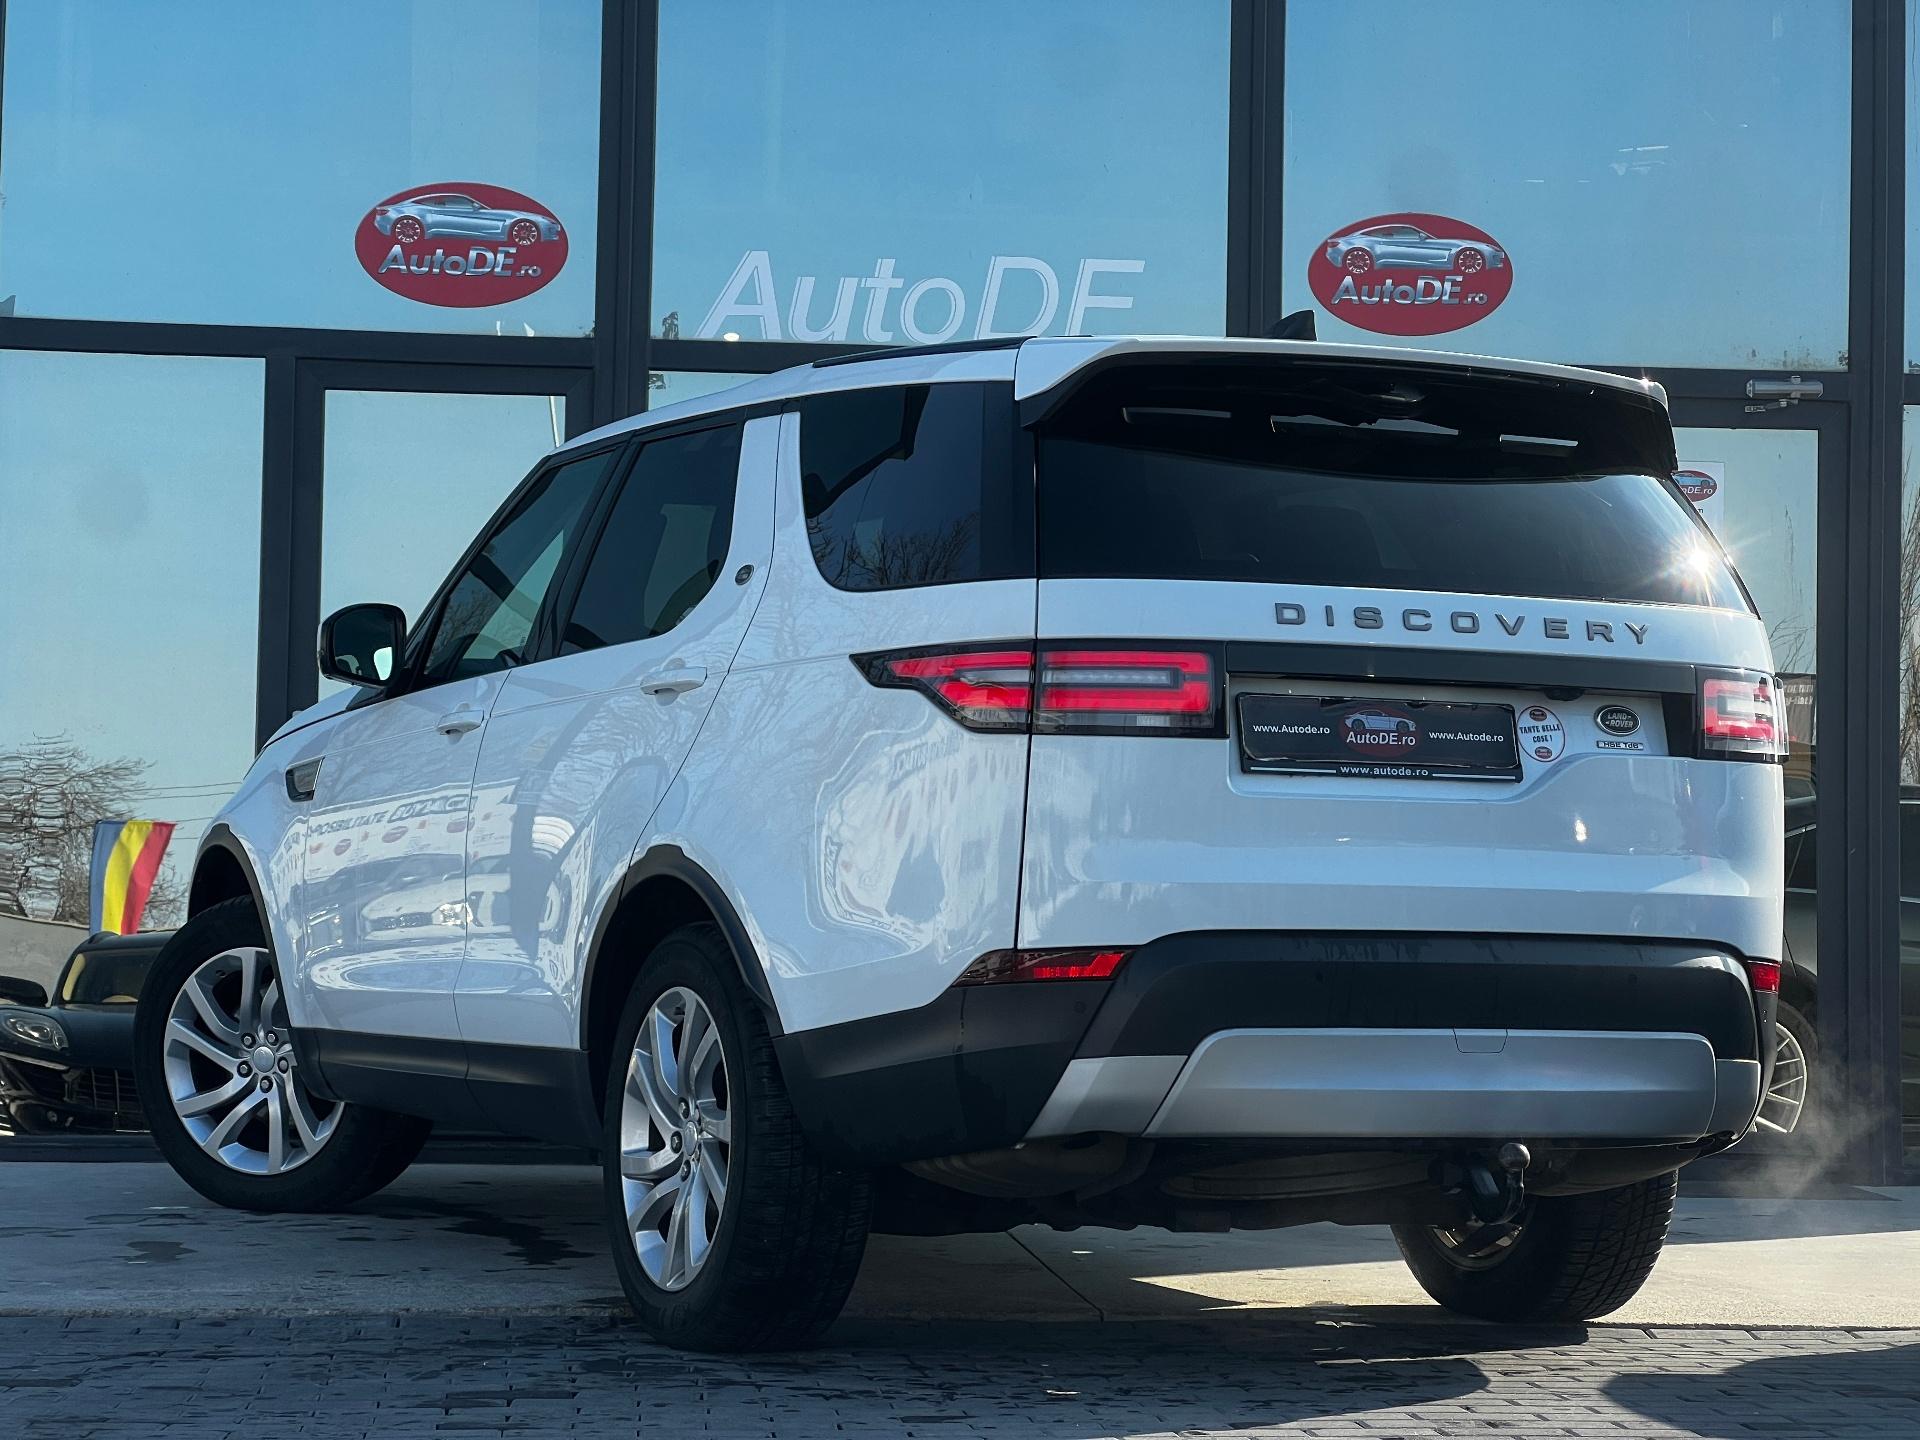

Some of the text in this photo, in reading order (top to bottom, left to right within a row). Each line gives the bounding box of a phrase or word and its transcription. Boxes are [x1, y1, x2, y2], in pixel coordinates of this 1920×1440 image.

[378, 244, 542, 278] AutoDE.ro
[1330, 275, 1489, 306] AutoDE.ro
[1275, 603, 1649, 645] DISCOVERY
[1253, 723, 1330, 734] www.Autode.ro
[1519, 725, 1541, 734] TANTE
[1610, 720, 1634, 728] ROVER
[1346, 731, 1416, 746] AutoDE.ro
[1429, 730, 1504, 742] www.Autode.ro
[1340, 765, 1429, 776] www.autode.ro
